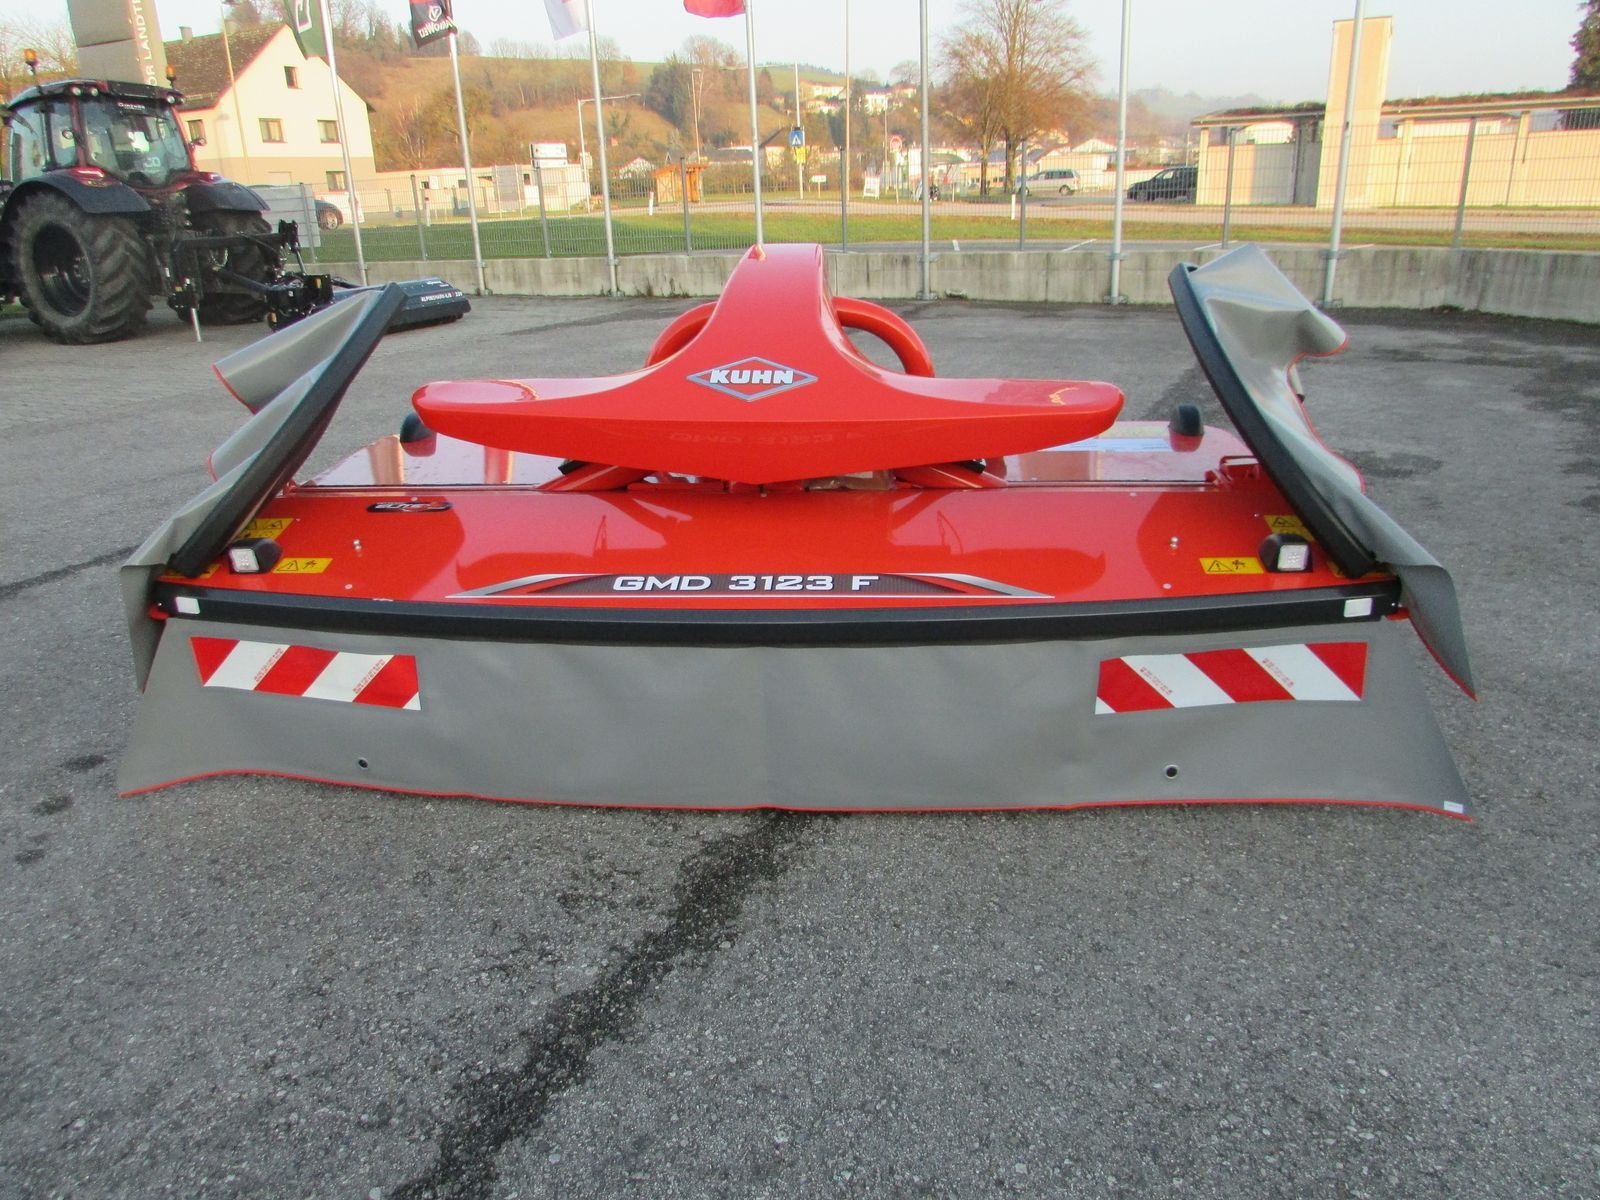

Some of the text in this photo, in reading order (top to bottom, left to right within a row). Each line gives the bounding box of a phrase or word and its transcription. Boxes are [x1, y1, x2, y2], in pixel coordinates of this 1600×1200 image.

[709, 370, 794, 384] KUHN
[613, 576, 879, 591] GMD 3123 F
